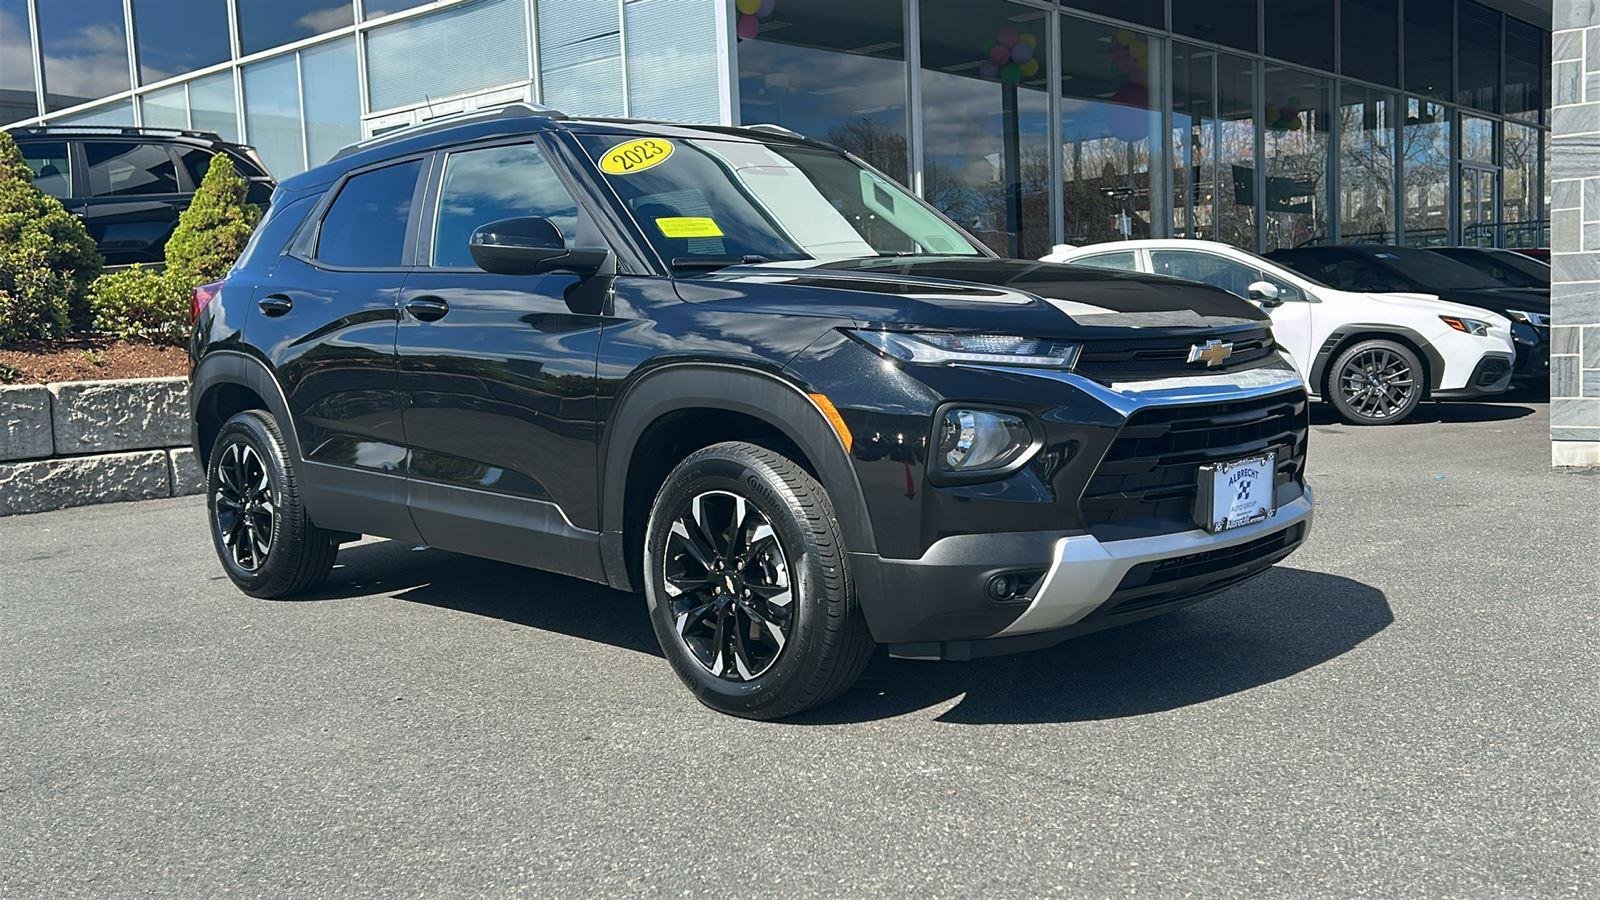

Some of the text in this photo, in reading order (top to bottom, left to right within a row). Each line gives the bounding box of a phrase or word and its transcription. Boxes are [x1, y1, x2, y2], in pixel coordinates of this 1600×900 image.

[613, 141, 664, 170] 2023
[1228, 468, 1259, 486] ALBRECHT
[1226, 515, 1250, 529] Albrecht
